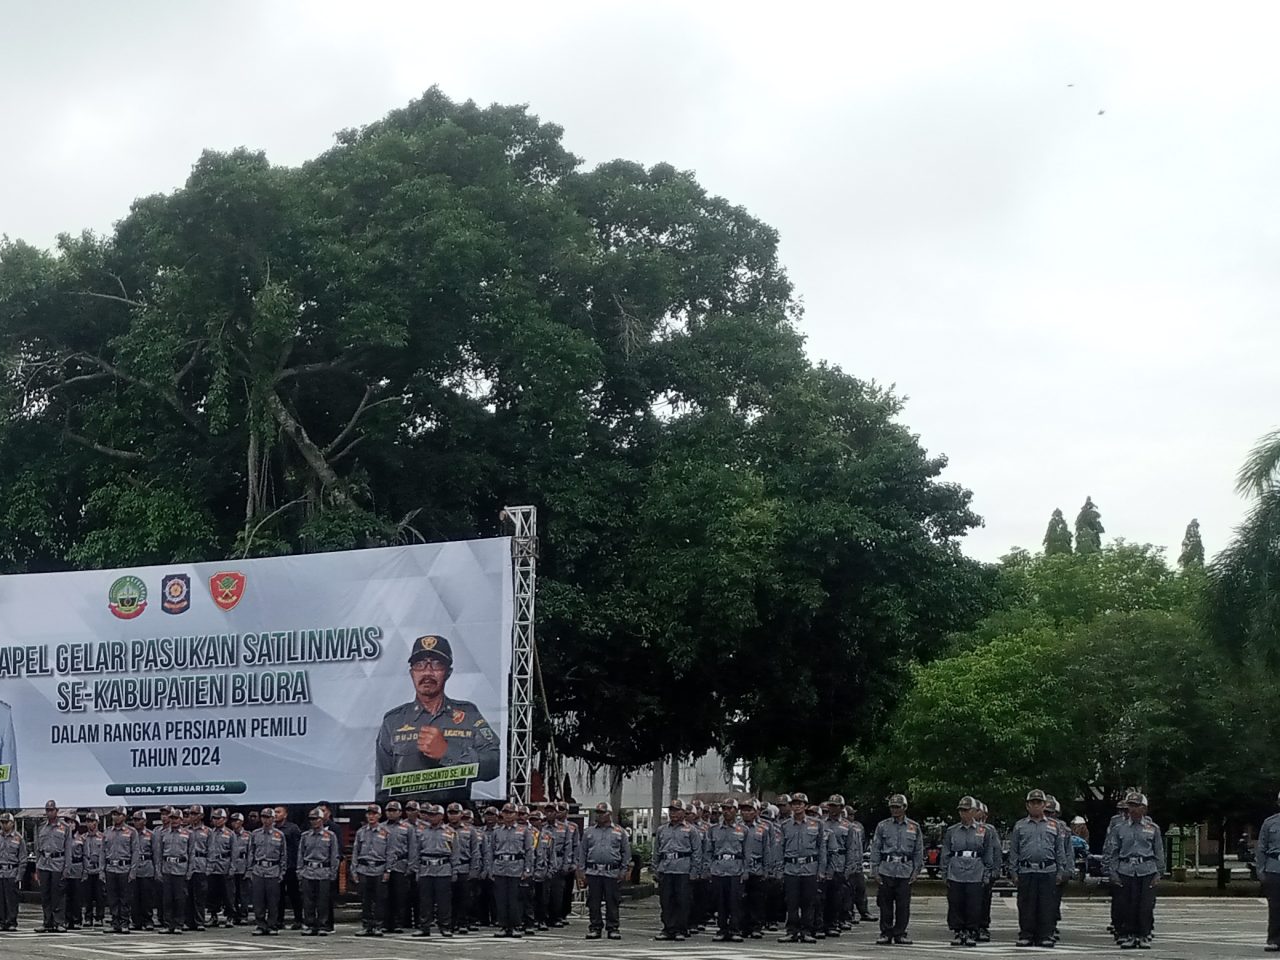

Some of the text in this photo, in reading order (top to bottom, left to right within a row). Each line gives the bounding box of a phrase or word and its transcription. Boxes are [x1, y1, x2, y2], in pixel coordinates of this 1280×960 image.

[56, 641, 124, 673] GELAR
[132, 635, 236, 669] PASUKAN
[243, 627, 381, 664] SATLINMAS
[57, 671, 308, 711] SE-KABUPATEN BLORA
[51, 717, 307, 744] DALAM RANGKA PERSIAPAN PEMILU
[130, 747, 220, 767] TAHUN 2024
[422, 769, 449, 781] SUSANTO
[125, 786, 155, 794] BLORA,
